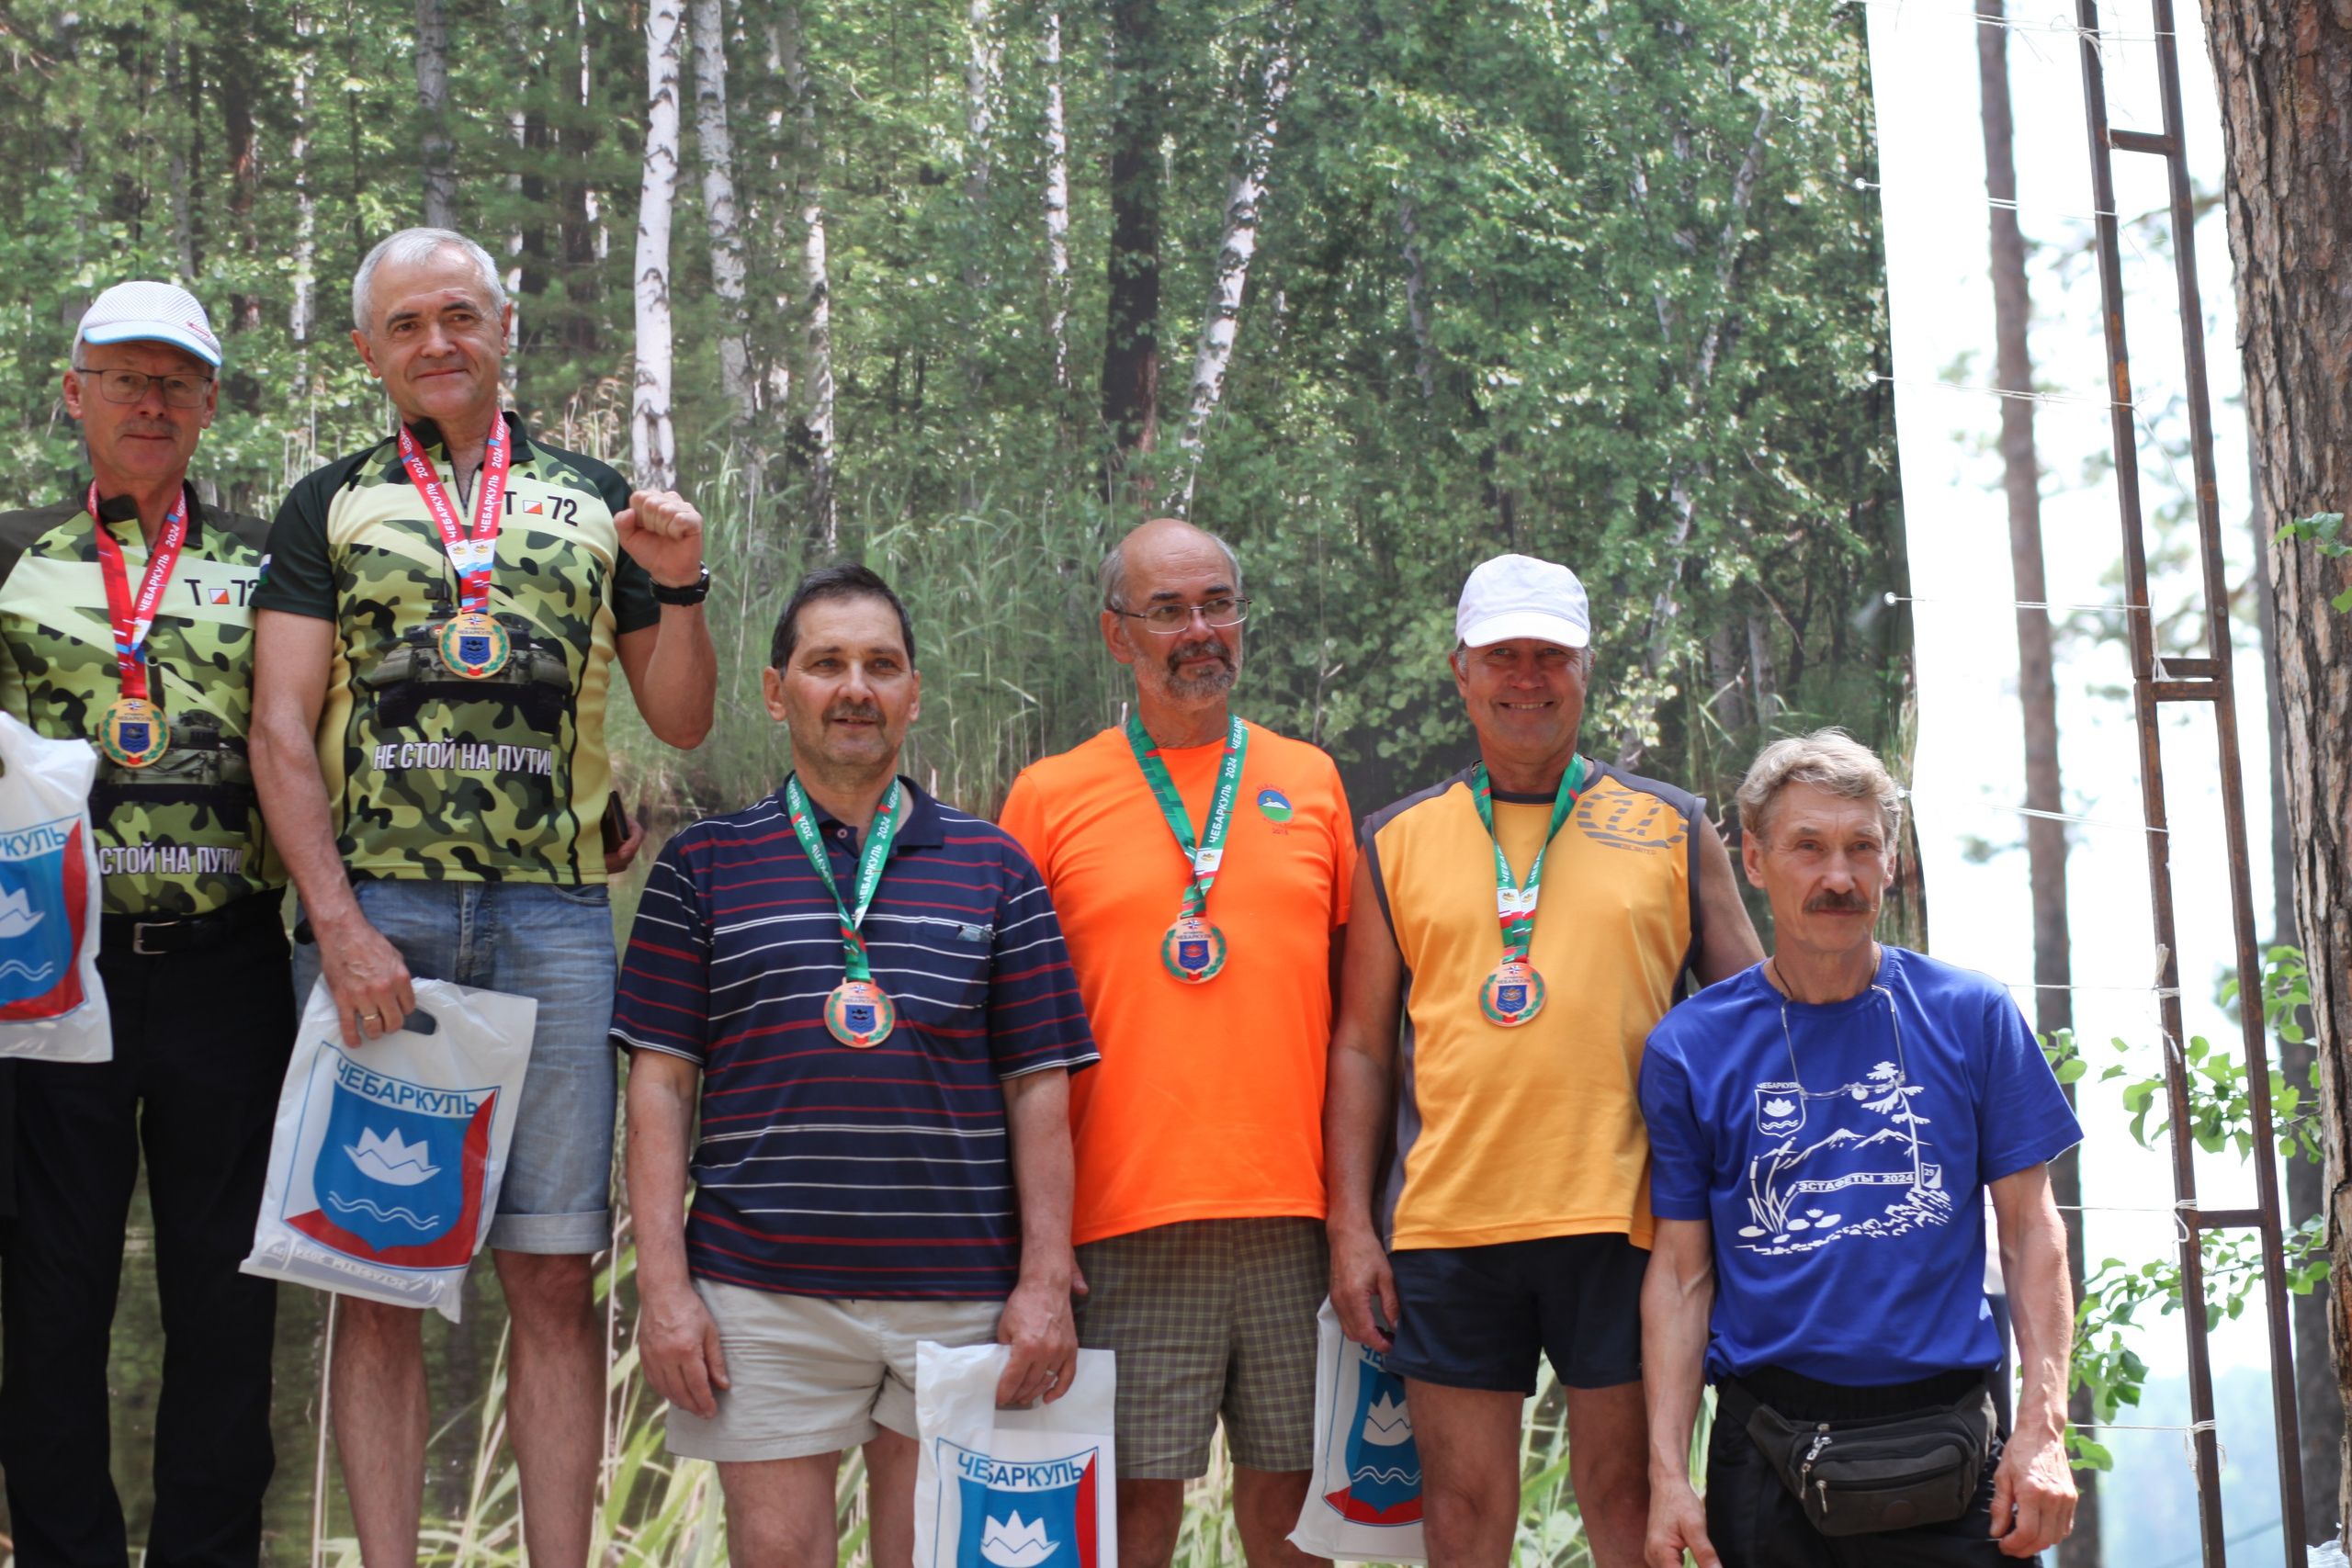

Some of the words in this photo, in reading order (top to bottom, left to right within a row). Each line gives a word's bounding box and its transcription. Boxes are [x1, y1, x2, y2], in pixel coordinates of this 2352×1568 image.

[411, 457, 429, 479] 2024
[479, 474, 500, 533] ЧЕБАРКУЛЬ
[492, 446, 504, 469] 2024
[425, 482, 458, 539] ЧЕБАРКУЛЬ
[547, 495, 579, 527] 72
[138, 554, 170, 613] ЧЕБАРКУЛЬ
[165, 524, 181, 548] 2024
[373, 744, 398, 771] НЕ
[400, 738, 456, 769] СТОЙ
[460, 743, 492, 770] НА
[497, 744, 551, 776] ПУТИ!
[1208, 784, 1232, 843] ЧЕБАРКУЛЬ
[1225, 757, 1238, 779] 2024
[0, 827, 69, 857] КУЛЬ
[798, 816, 814, 840] 2024
[98, 841, 155, 874] СТОЙ
[160, 846, 192, 874] НА
[858, 844, 883, 904] ЧЕБАРКУЛЬ
[876, 816, 891, 840] 2024
[336, 1058, 480, 1116] ЧЕБАРКУЛЬ
[1798, 1174, 1874, 1191] ЭСТАФЕТЫ
[1883, 1173, 1914, 1183] 2024
[1924, 1168, 1935, 1177] 29
